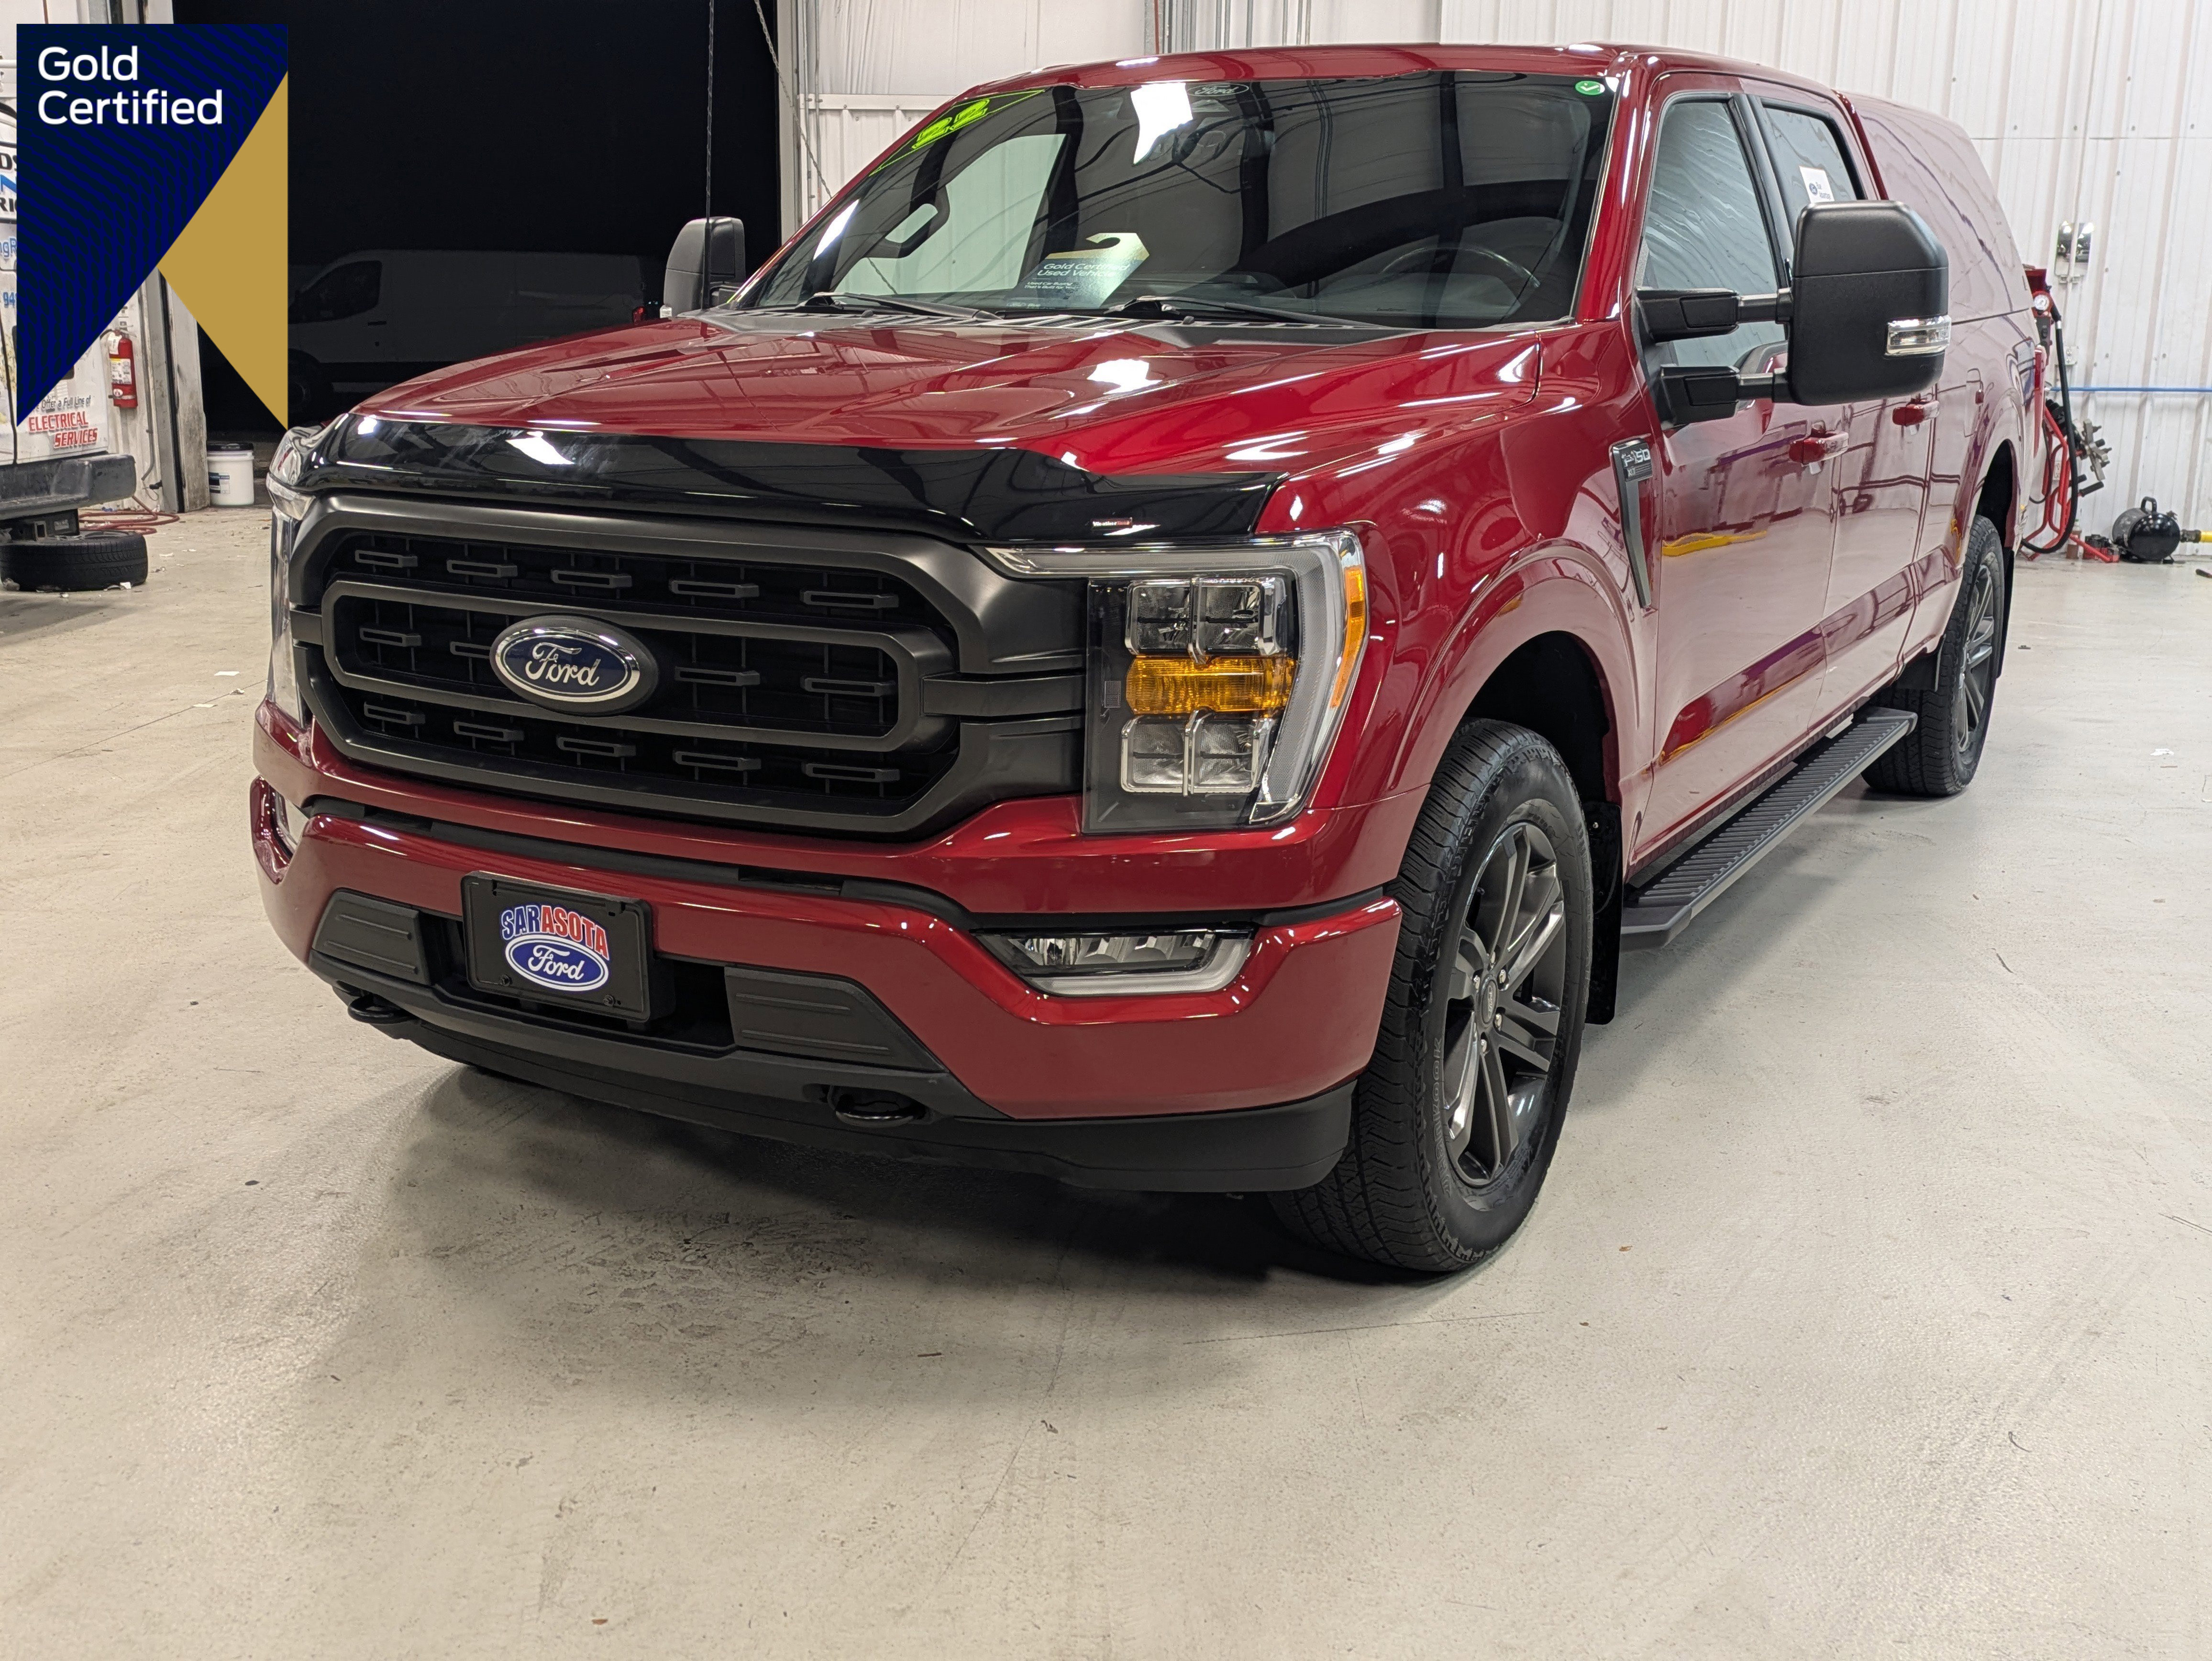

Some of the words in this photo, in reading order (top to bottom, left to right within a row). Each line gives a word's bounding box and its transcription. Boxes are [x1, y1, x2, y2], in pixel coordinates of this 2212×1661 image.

[1194, 85, 1239, 95] Ford
[42, 399, 56, 409] Offer
[64, 397, 73, 406] Full
[75, 397, 85, 405] Line
[86, 395, 91, 404] of
[28, 410, 89, 432] ELECTRICAL
[54, 428, 98, 448] SERVICES
[525, 642, 601, 686] Ford
[501, 905, 610, 961] SARASOTA
[528, 944, 585, 981] Ford
